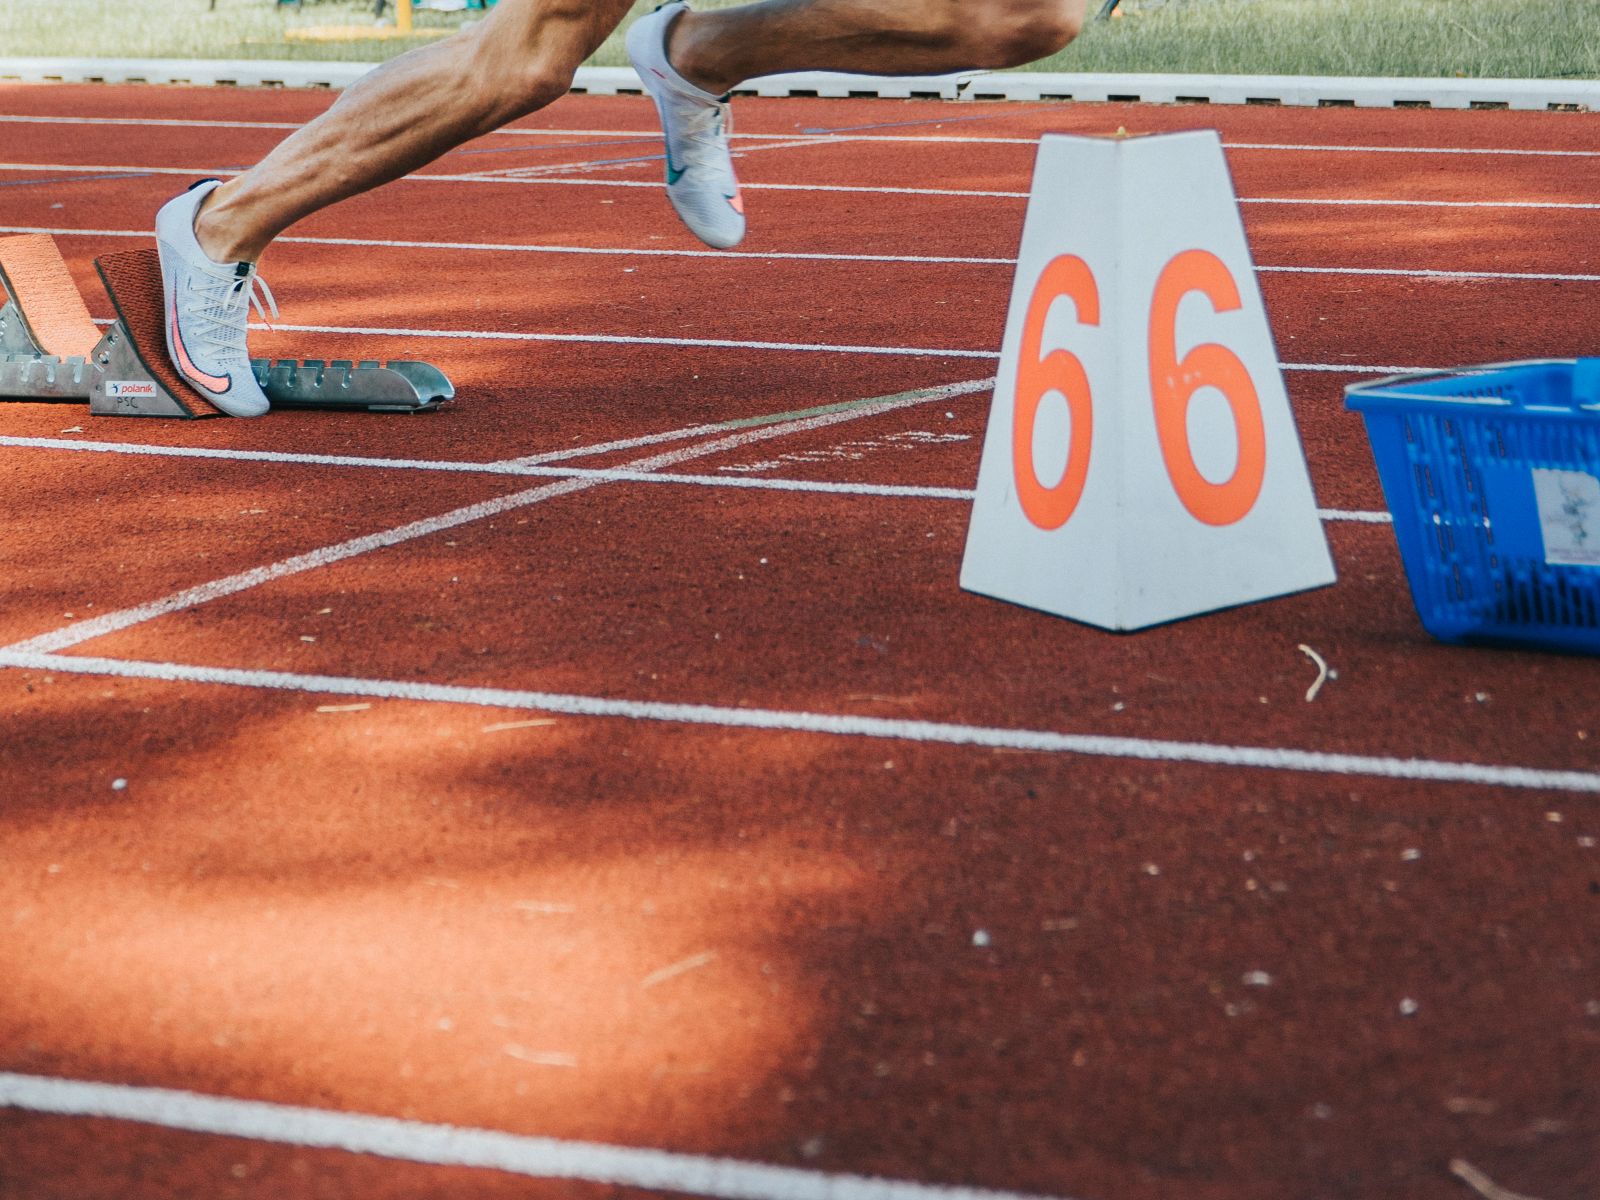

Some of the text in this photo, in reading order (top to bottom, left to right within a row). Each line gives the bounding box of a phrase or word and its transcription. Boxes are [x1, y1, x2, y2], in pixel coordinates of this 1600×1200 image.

[121, 383, 153, 394] polanik
[1012, 253, 1100, 531] 6
[1147, 248, 1267, 528] 6
